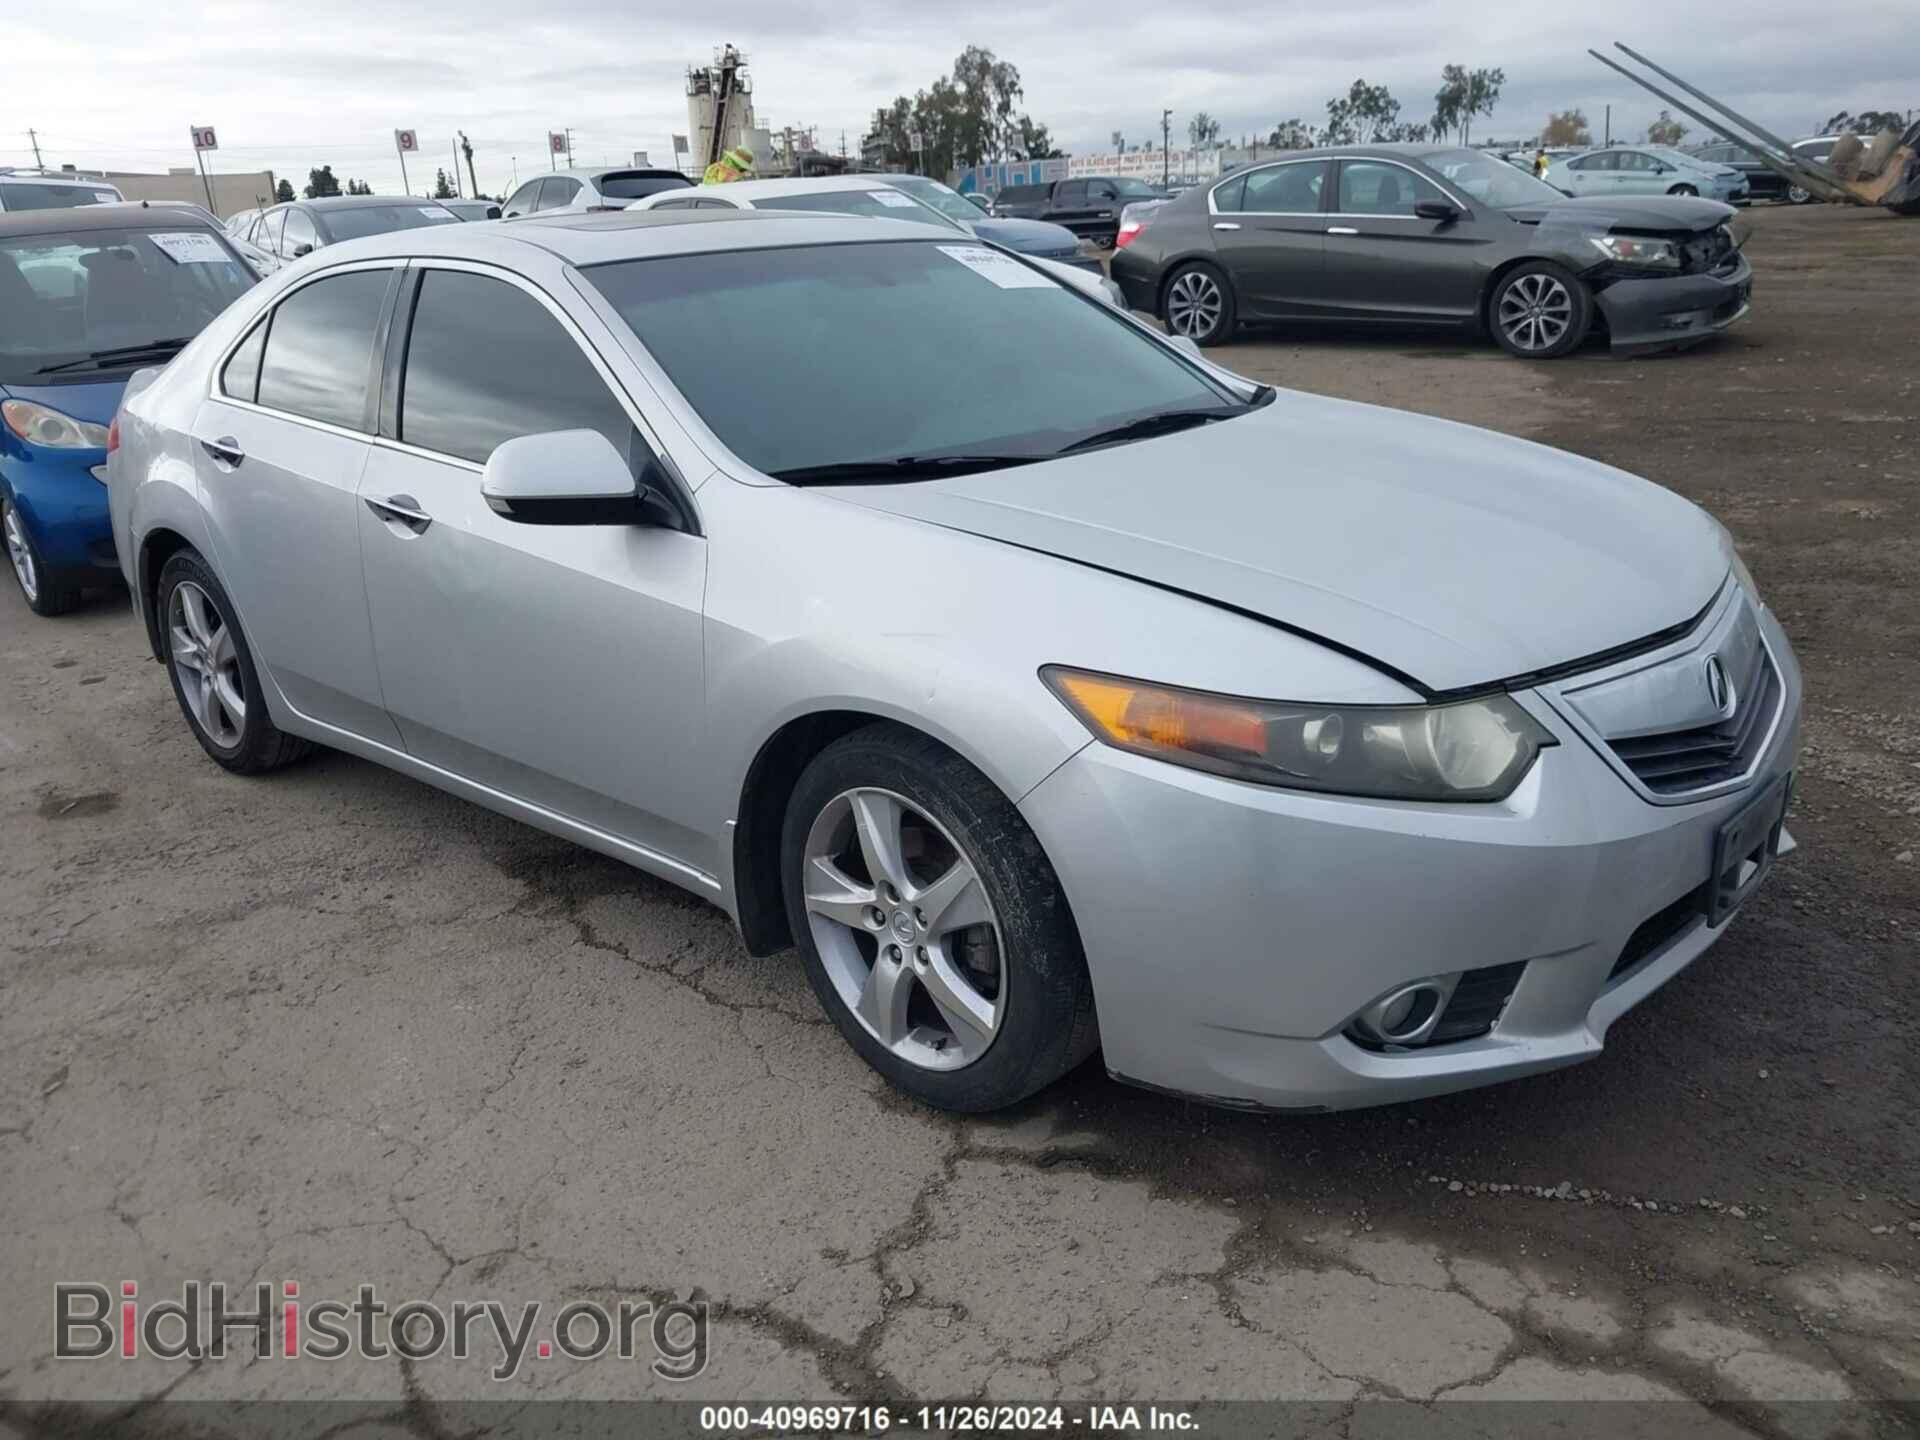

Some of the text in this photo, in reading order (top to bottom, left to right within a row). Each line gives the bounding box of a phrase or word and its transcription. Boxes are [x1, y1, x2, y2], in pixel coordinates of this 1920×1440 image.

[193, 131, 216, 148] 10
[400, 132, 413, 149] 9
[553, 136, 562, 152] 8
